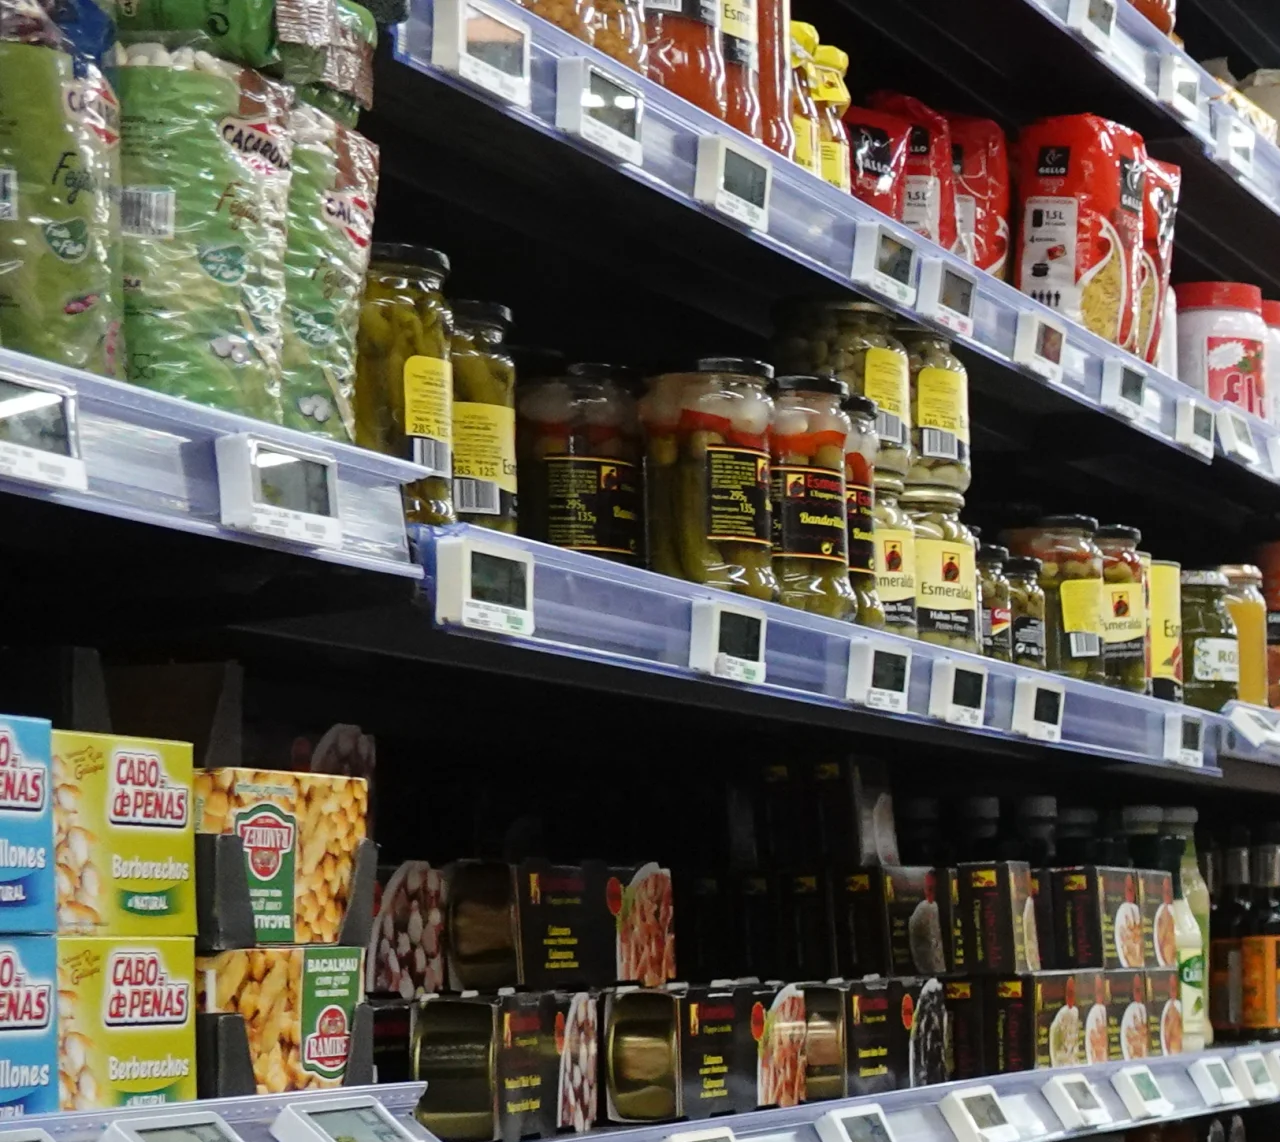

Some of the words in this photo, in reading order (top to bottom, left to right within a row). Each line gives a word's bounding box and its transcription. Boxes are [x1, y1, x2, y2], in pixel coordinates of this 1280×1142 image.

[1038, 165, 1067, 175] GALLO
[920, 581, 972, 601] Esmeralda
[115, 756, 160, 788] CABO
[112, 789, 131, 817] de
[111, 854, 190, 880] Berberechos
[112, 956, 159, 987] CABO
[306, 957, 359, 973] BACALHAU
[108, 989, 127, 1019] de
[308, 1036, 348, 1059] RAMIRE
[108, 1053, 190, 1081] Berberechos
